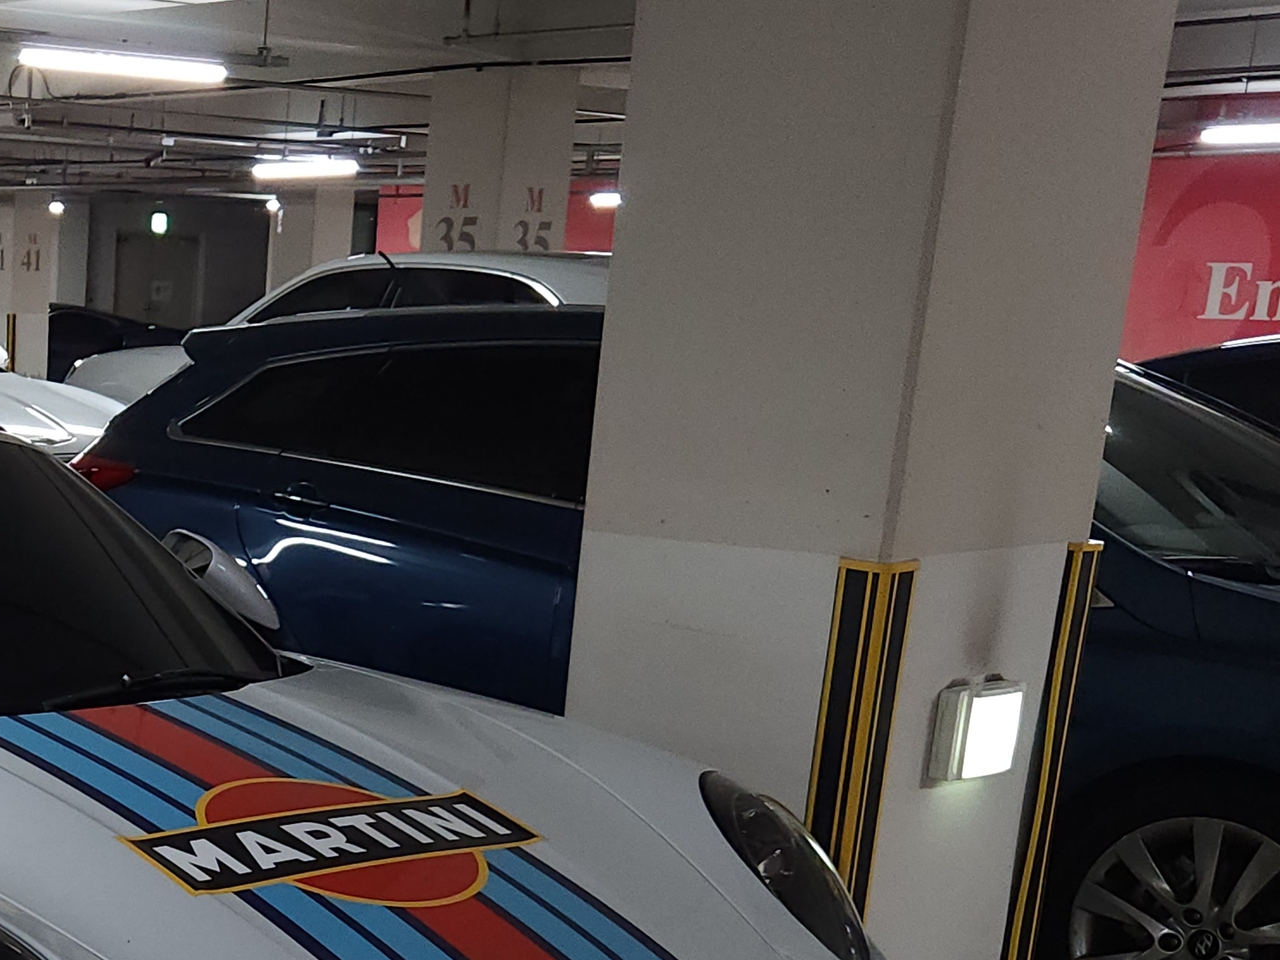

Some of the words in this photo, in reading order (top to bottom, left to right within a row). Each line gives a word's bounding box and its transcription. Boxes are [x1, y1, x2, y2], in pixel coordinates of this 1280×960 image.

[450, 184, 471, 209] M
[525, 187, 544, 213] M
[435, 216, 478, 251] 35
[514, 220, 552, 251] 35
[21, 248, 41, 272] 41
[152, 803, 512, 881] MARTINI
